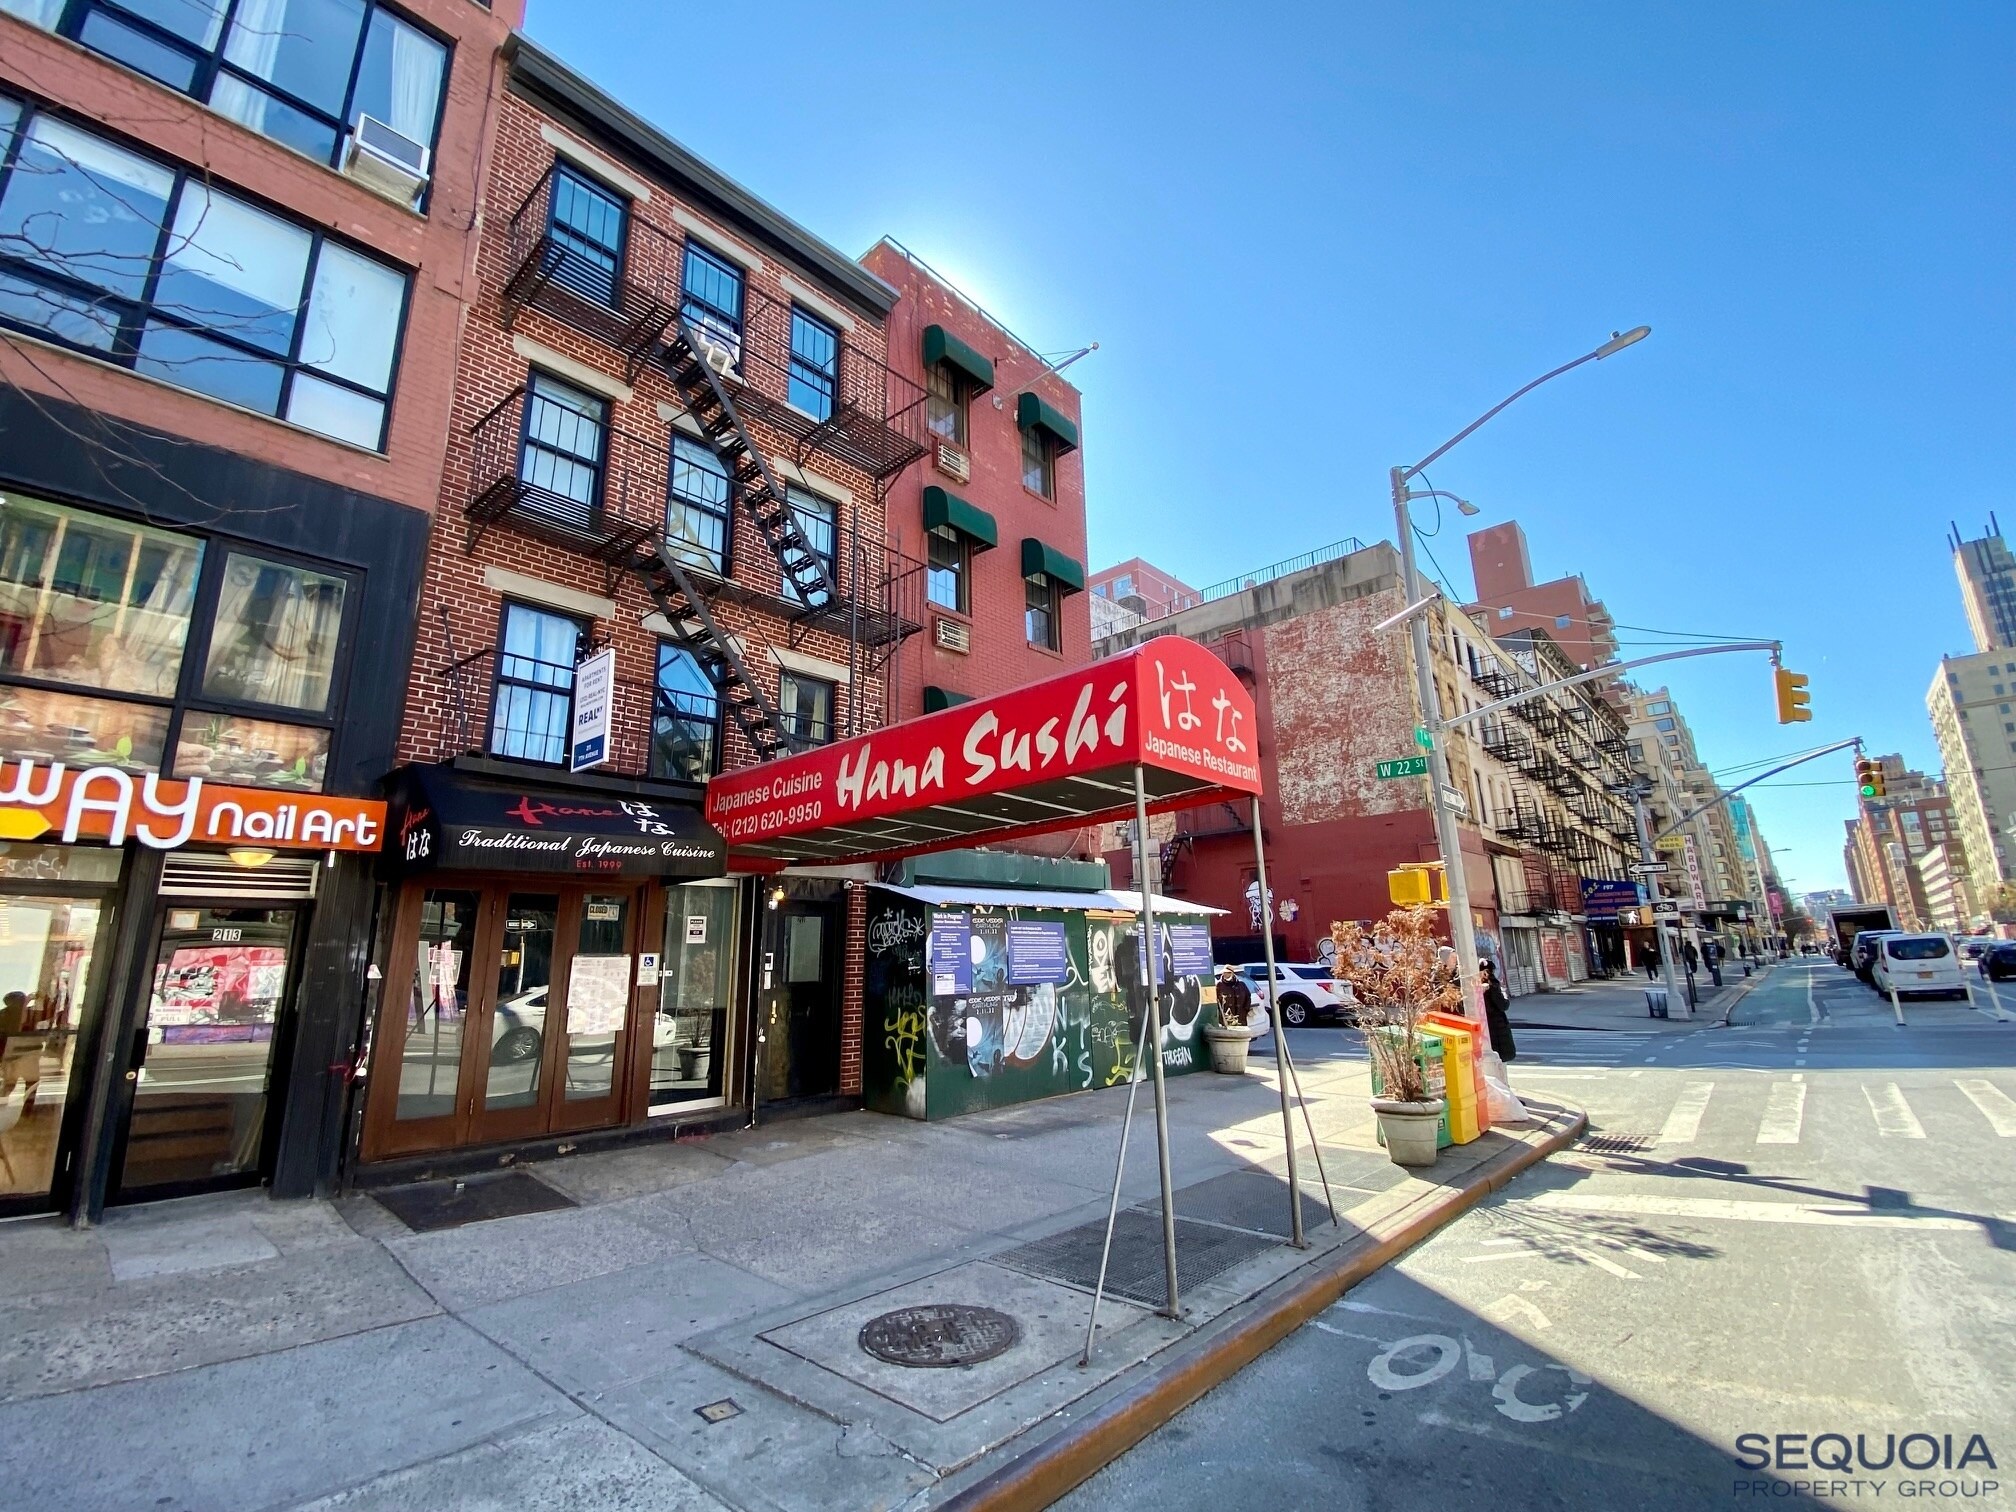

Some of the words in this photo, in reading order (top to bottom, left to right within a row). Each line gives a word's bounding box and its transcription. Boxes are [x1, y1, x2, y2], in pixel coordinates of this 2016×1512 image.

[1155, 660, 1247, 752] はな
[835, 743, 945, 811] Hana
[963, 681, 1128, 786] Sushi
[1145, 730, 1202, 766] Japanese
[1203, 748, 1258, 783] Restaurant
[1380, 763, 1391, 777] W
[1397, 760, 1411, 775] 22
[1415, 758, 1424, 768] St
[713, 785, 770, 815] Japanese
[772, 770, 823, 799] Cuisine
[207, 801, 298, 840] Nail
[301, 809, 378, 846] Art
[731, 815, 758, 838] (212)
[761, 800, 822, 831] 620-9950
[406, 828, 431, 862] はな
[458, 829, 573, 851] Traditional
[575, 837, 657, 858] Japanese
[660, 841, 716, 860] Cuisine
[576, 859, 593, 868] Est.
[1684, 836, 1704, 909] HARDWARE
[213, 929, 242, 942] 213
